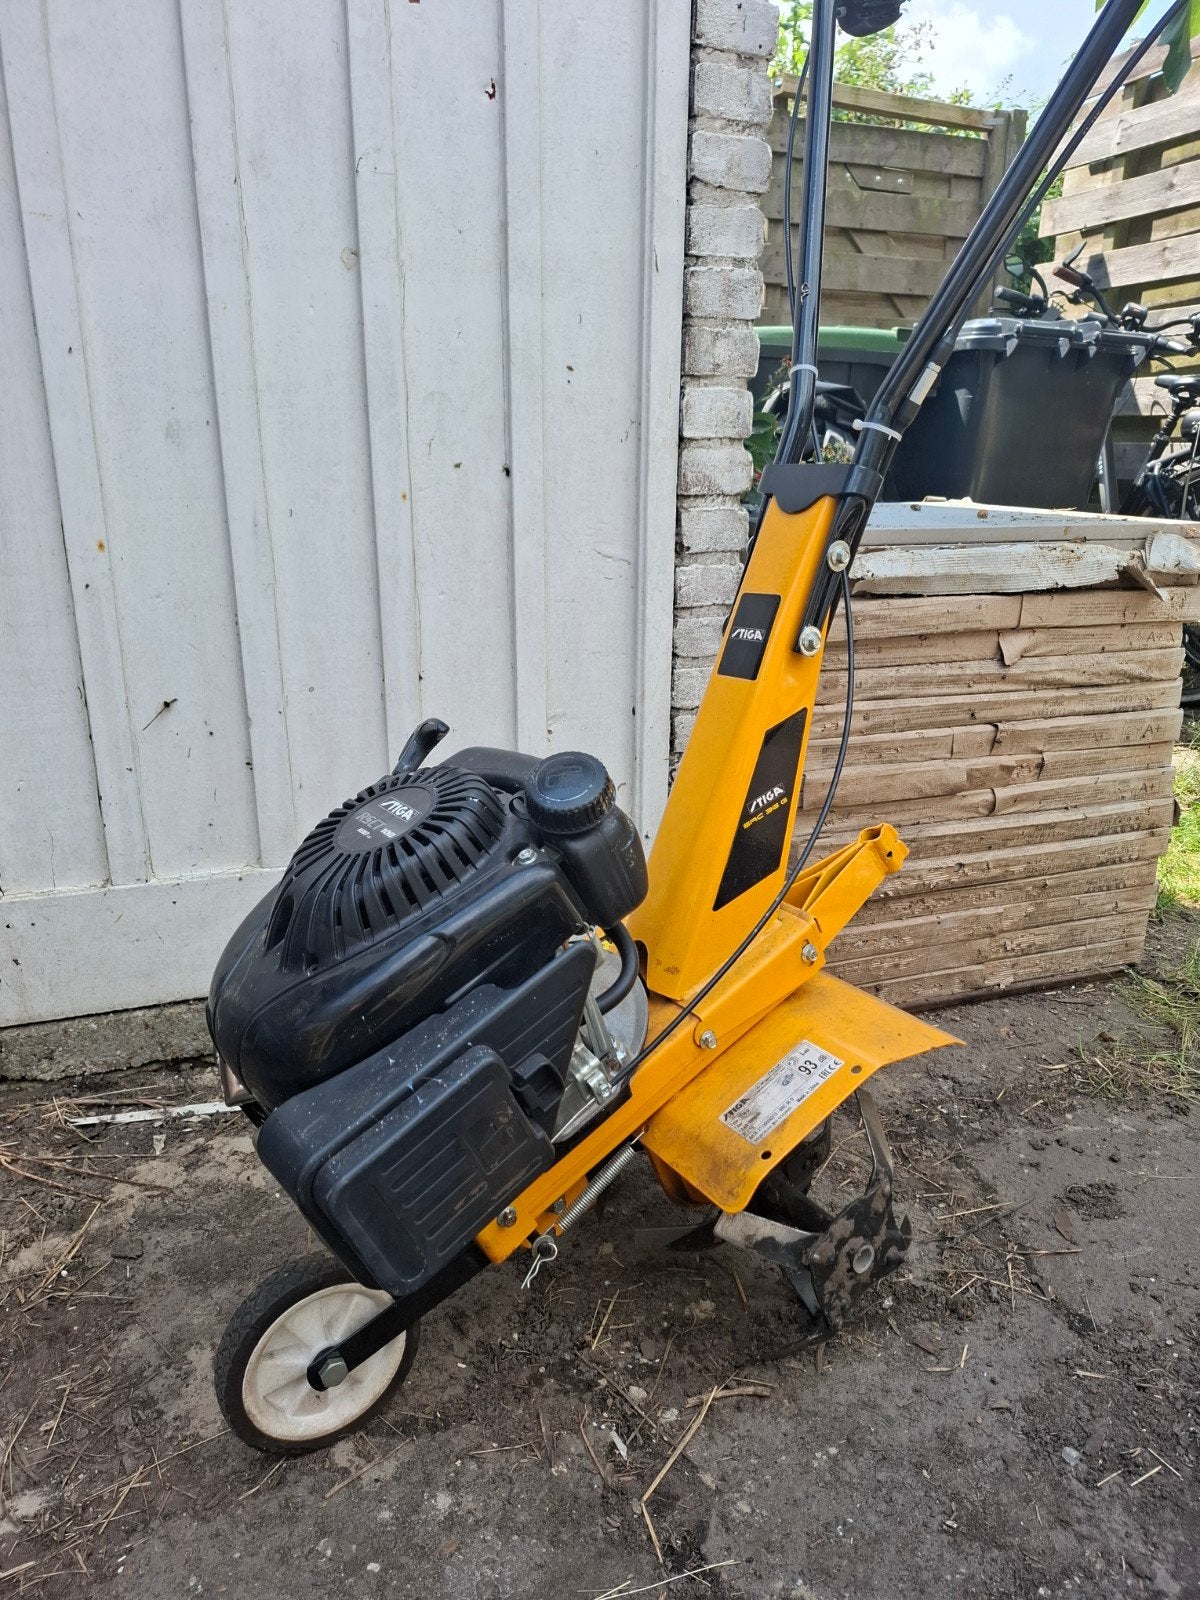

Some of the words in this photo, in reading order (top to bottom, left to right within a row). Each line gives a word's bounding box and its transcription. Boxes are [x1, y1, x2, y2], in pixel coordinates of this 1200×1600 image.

[731, 628, 763, 641] STIGA
[750, 786, 784, 813] STIGA
[380, 800, 414, 821] STIGA
[798, 1060, 818, 1075] 93
[724, 1098, 750, 1121] STIGA
